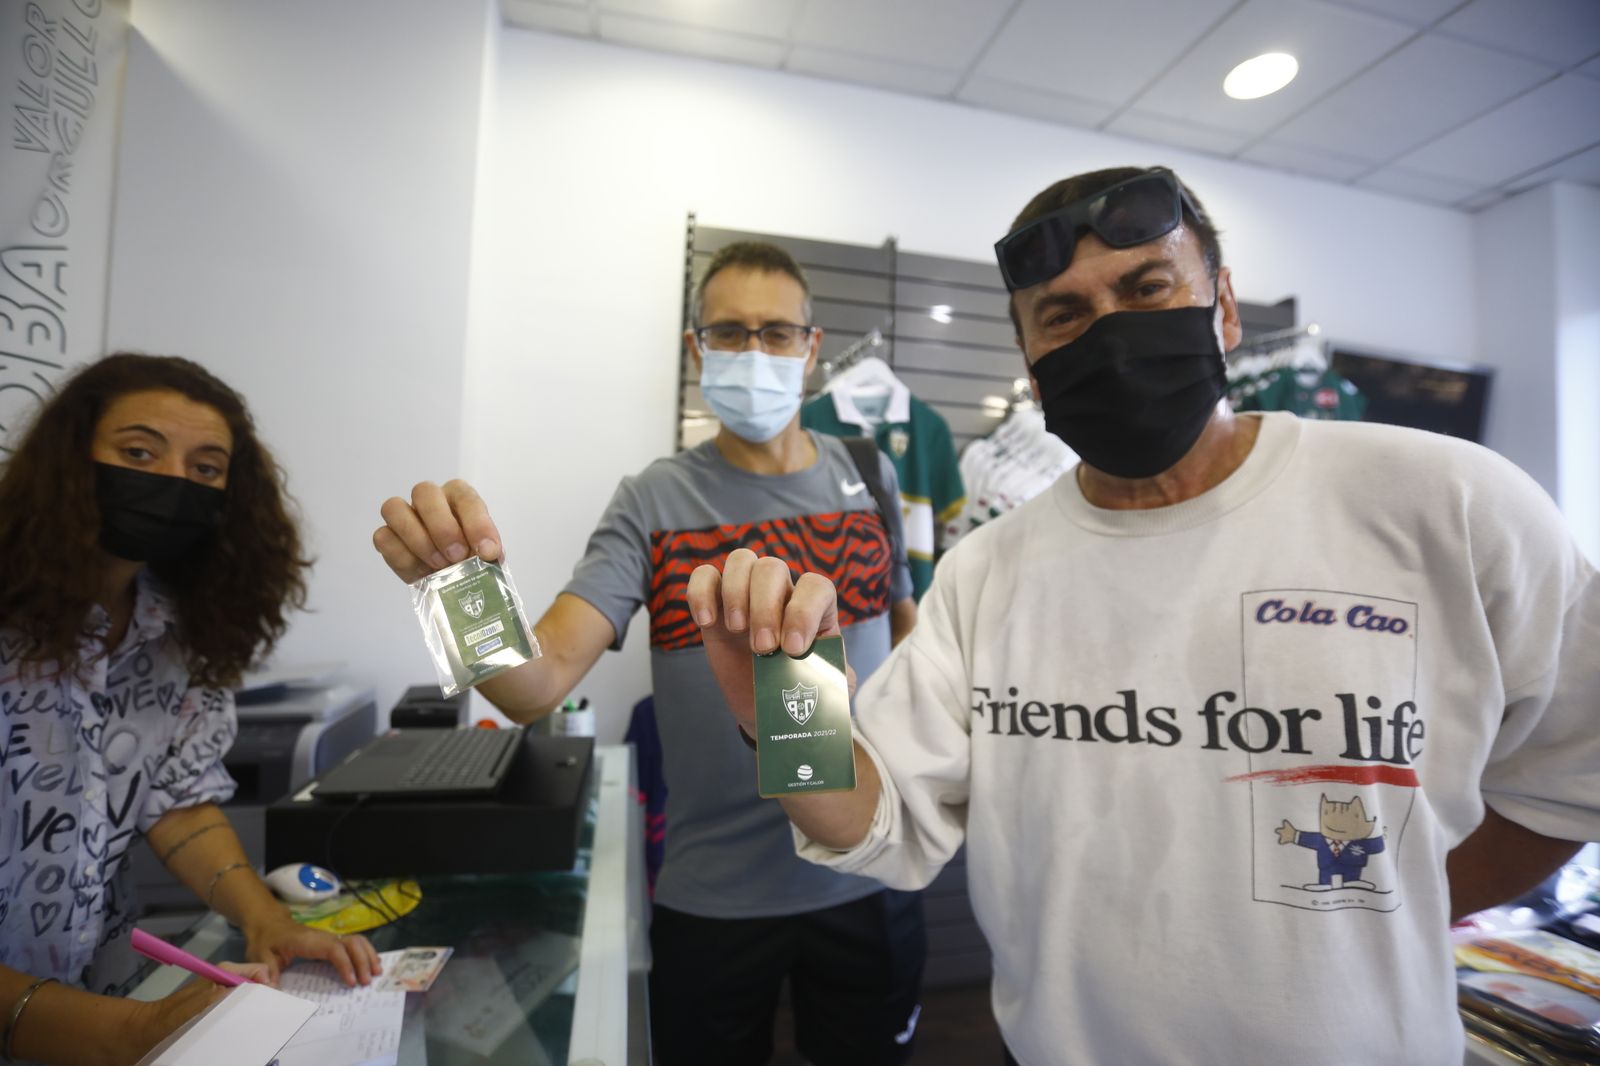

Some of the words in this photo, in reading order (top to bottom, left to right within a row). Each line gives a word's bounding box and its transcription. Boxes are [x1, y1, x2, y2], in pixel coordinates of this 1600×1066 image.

[14, 1, 57, 153] VALOR
[1256, 599, 1336, 625] Cola
[1346, 604, 1409, 635] Cao
[770, 731, 812, 741] TEMPORADA
[813, 729, 837, 738] 2021/22
[1197, 690, 1322, 754] for
[1335, 692, 1426, 766] life
